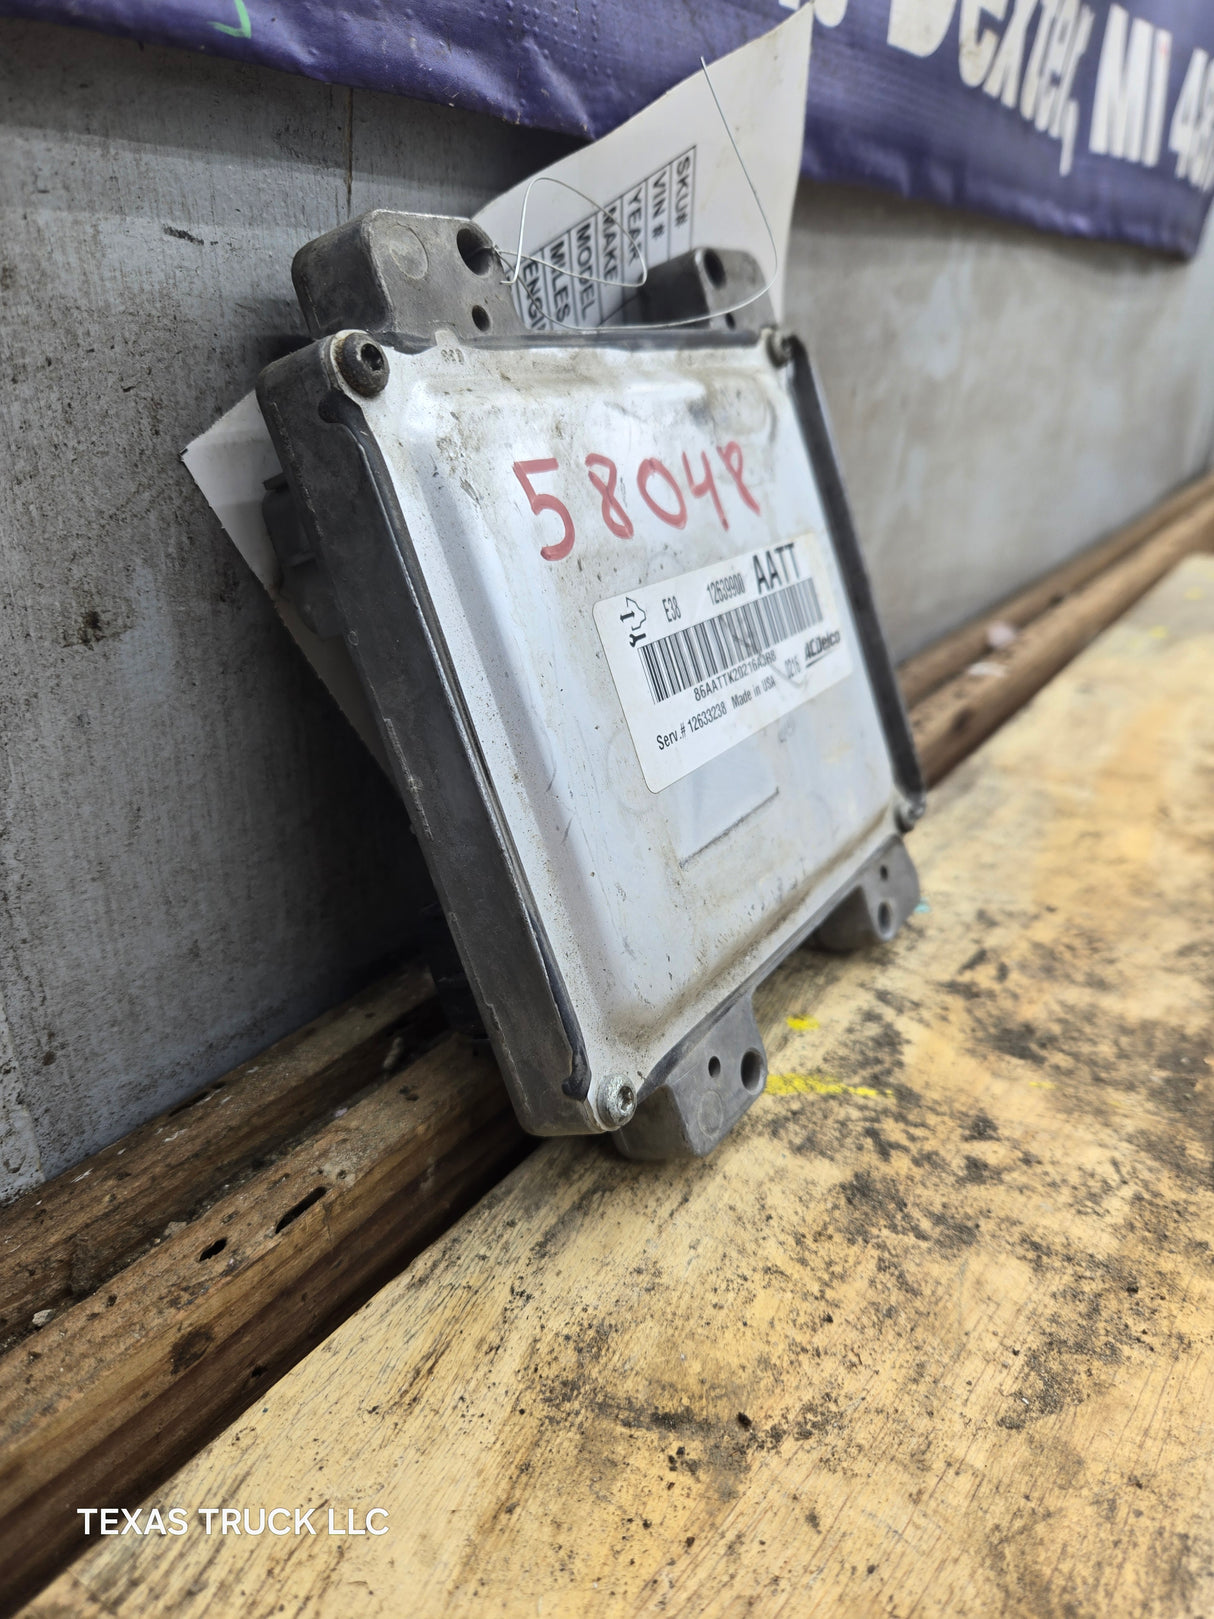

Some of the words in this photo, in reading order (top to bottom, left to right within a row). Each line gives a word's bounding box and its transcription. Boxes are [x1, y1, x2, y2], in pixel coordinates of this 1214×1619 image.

[1088, 3, 1173, 167] MI
[628, 188, 643, 265] YEAR
[652, 173, 666, 218] VIN
[676, 156, 691, 227] SKU#
[550, 240, 571, 323] MILES
[576, 222, 597, 322] MODEL
[602, 206, 619, 281] MAKE
[662, 596, 682, 624] E38
[752, 542, 800, 595] AATT
[687, 702, 728, 733] 12633238
[731, 690, 752, 709] Made
[753, 683, 762, 697] in
[761, 675, 777, 693] USA
